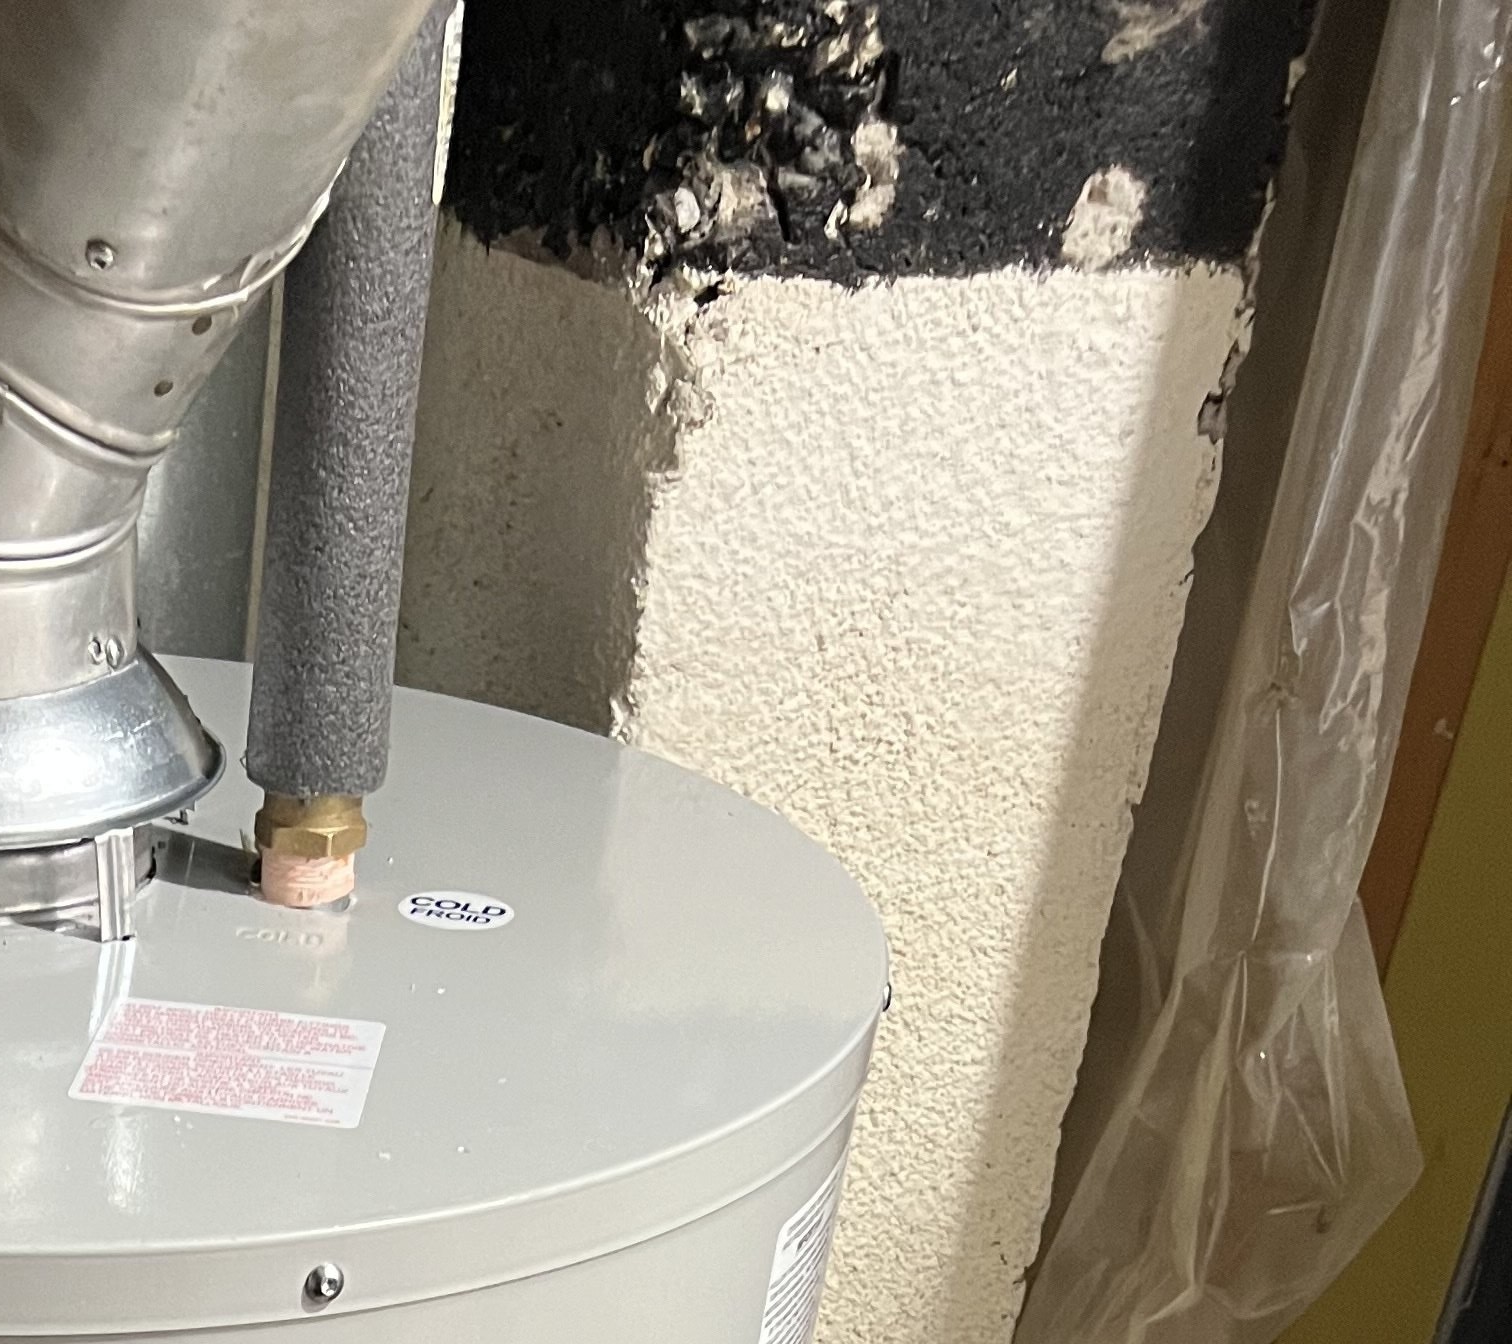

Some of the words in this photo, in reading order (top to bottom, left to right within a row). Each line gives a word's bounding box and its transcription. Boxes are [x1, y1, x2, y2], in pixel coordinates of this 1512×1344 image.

[410, 896, 506, 918] COLD
[411, 907, 491, 924] FROID
[235, 927, 324, 948] COLD
